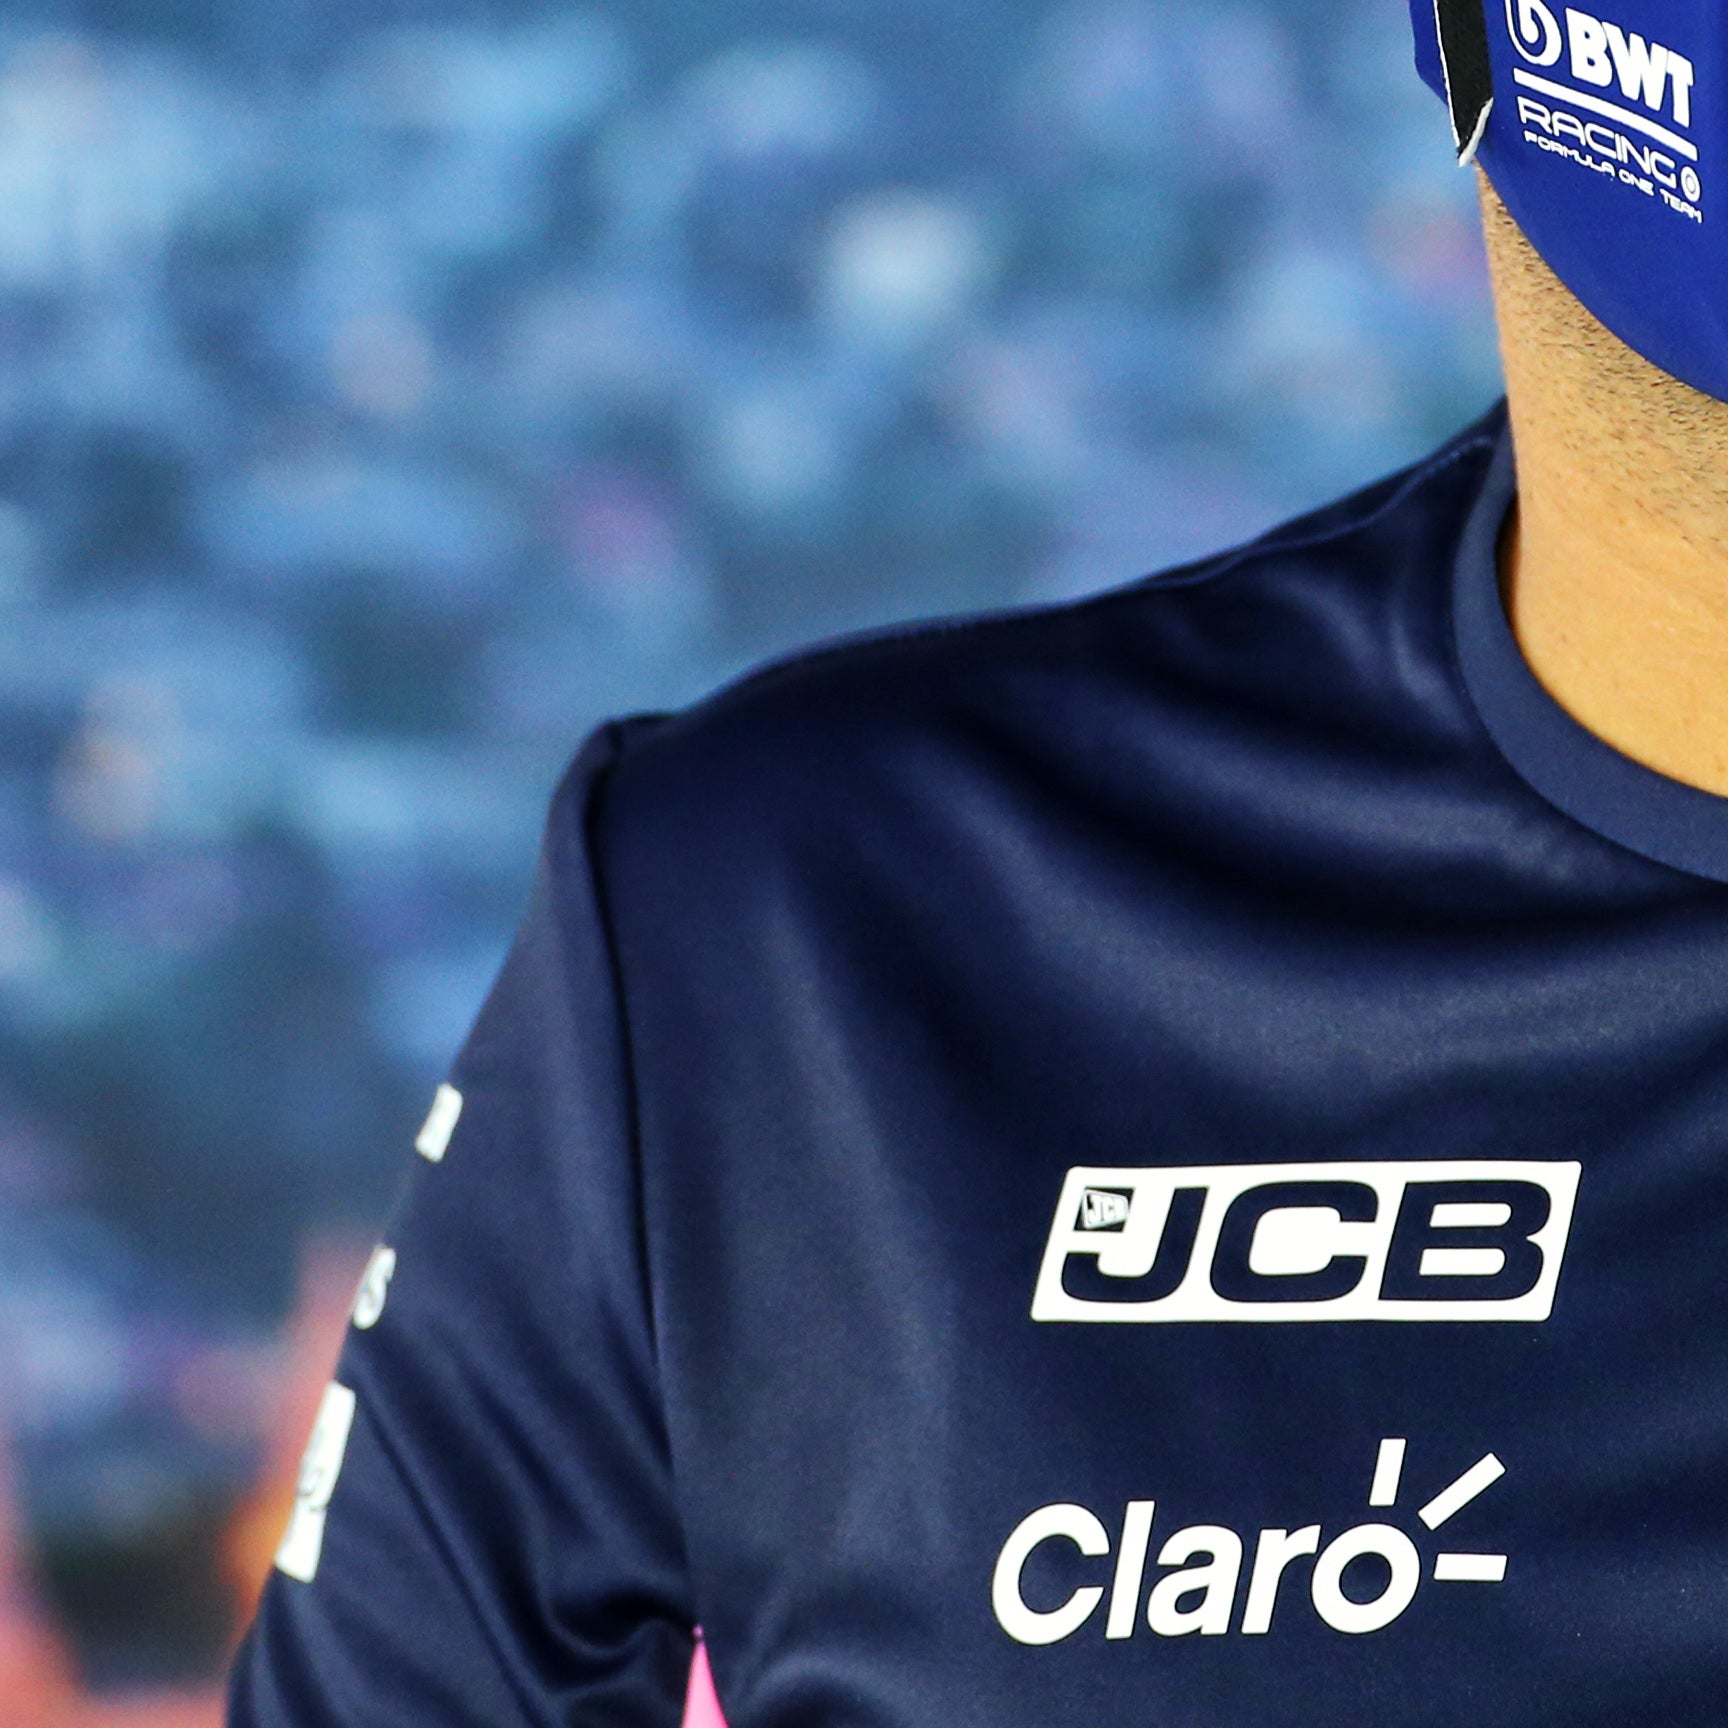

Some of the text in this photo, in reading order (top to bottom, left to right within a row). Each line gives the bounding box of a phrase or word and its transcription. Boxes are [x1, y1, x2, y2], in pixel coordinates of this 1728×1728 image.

[1565, 7, 1694, 129] BWT
[1524, 130, 1703, 224] FORMULA ONE TEAM
[1060, 1178, 1552, 1303] JCB
[991, 1498, 1421, 1646] Claro
